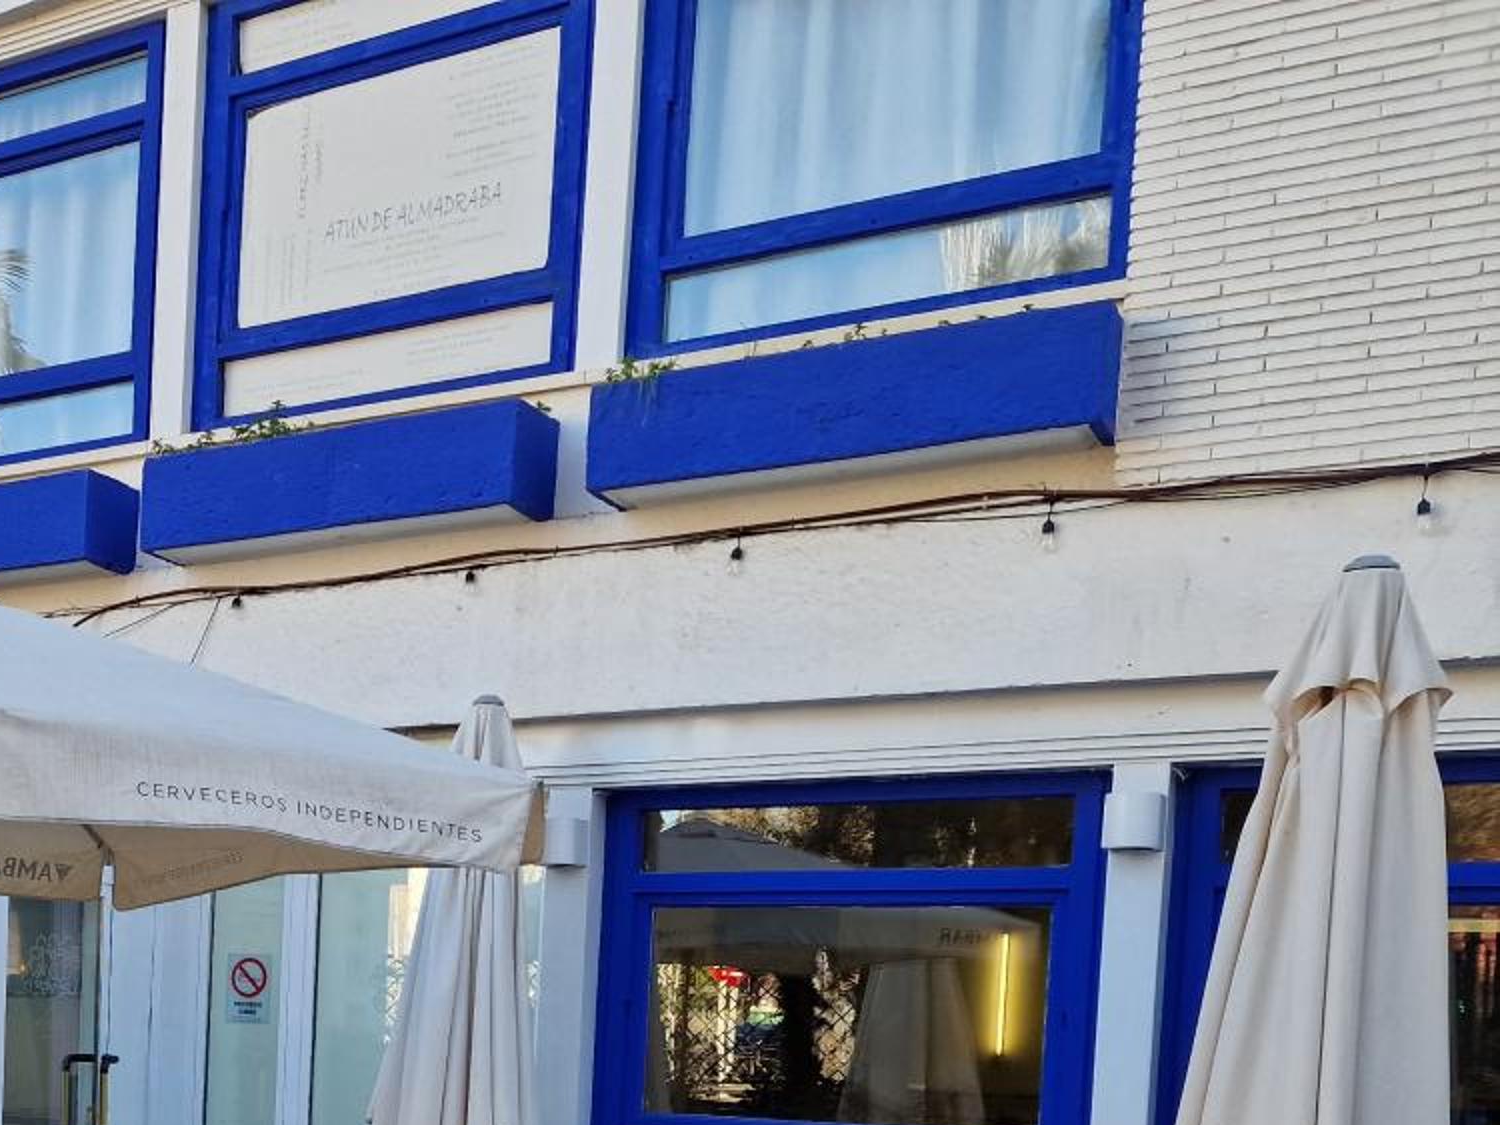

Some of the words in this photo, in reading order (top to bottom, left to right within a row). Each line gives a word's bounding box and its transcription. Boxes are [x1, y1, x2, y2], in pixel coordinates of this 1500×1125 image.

[372, 207, 392, 232] DE
[397, 182, 501, 227] ALMADRABA
[136, 781, 288, 813] CERVECEROS
[297, 800, 484, 844] INDEPENDIENTES
